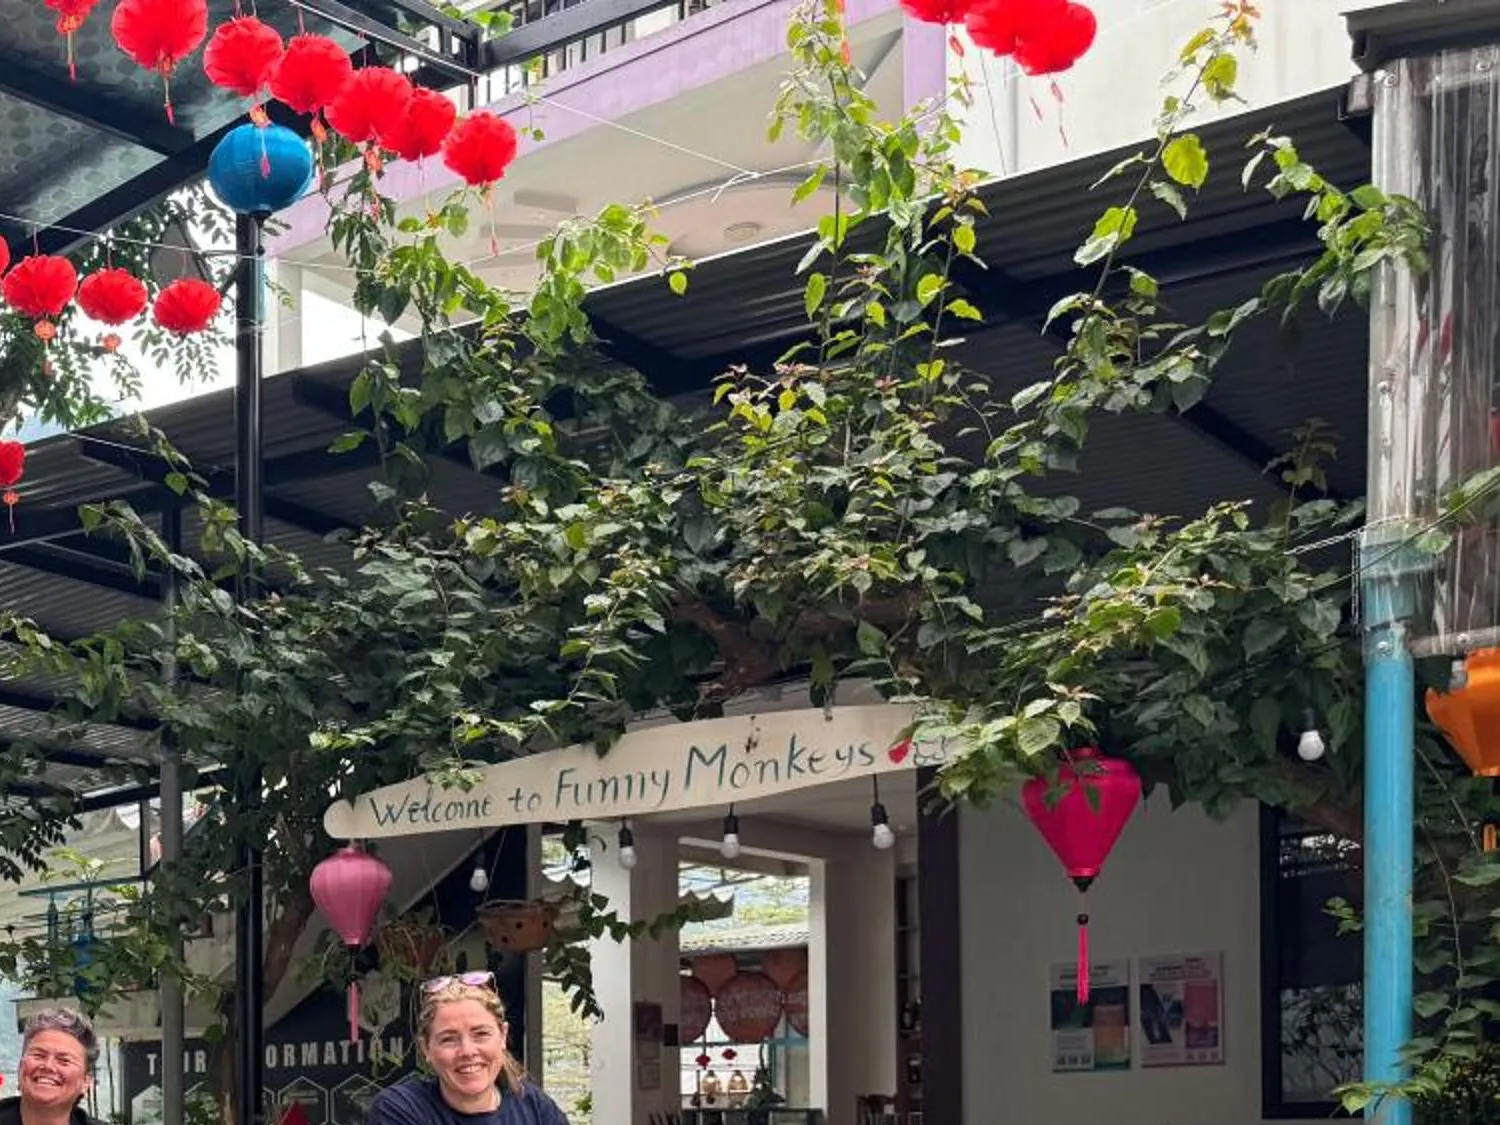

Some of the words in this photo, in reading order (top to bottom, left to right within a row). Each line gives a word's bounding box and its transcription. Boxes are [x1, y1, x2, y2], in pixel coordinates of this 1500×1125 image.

[368, 786, 493, 827] Welcome
[507, 786, 543, 813] to
[554, 767, 671, 808] Funny
[684, 732, 876, 791] Monkeys
[146, 1050, 208, 1076] TR
[264, 1036, 404, 1069] ORMATION
